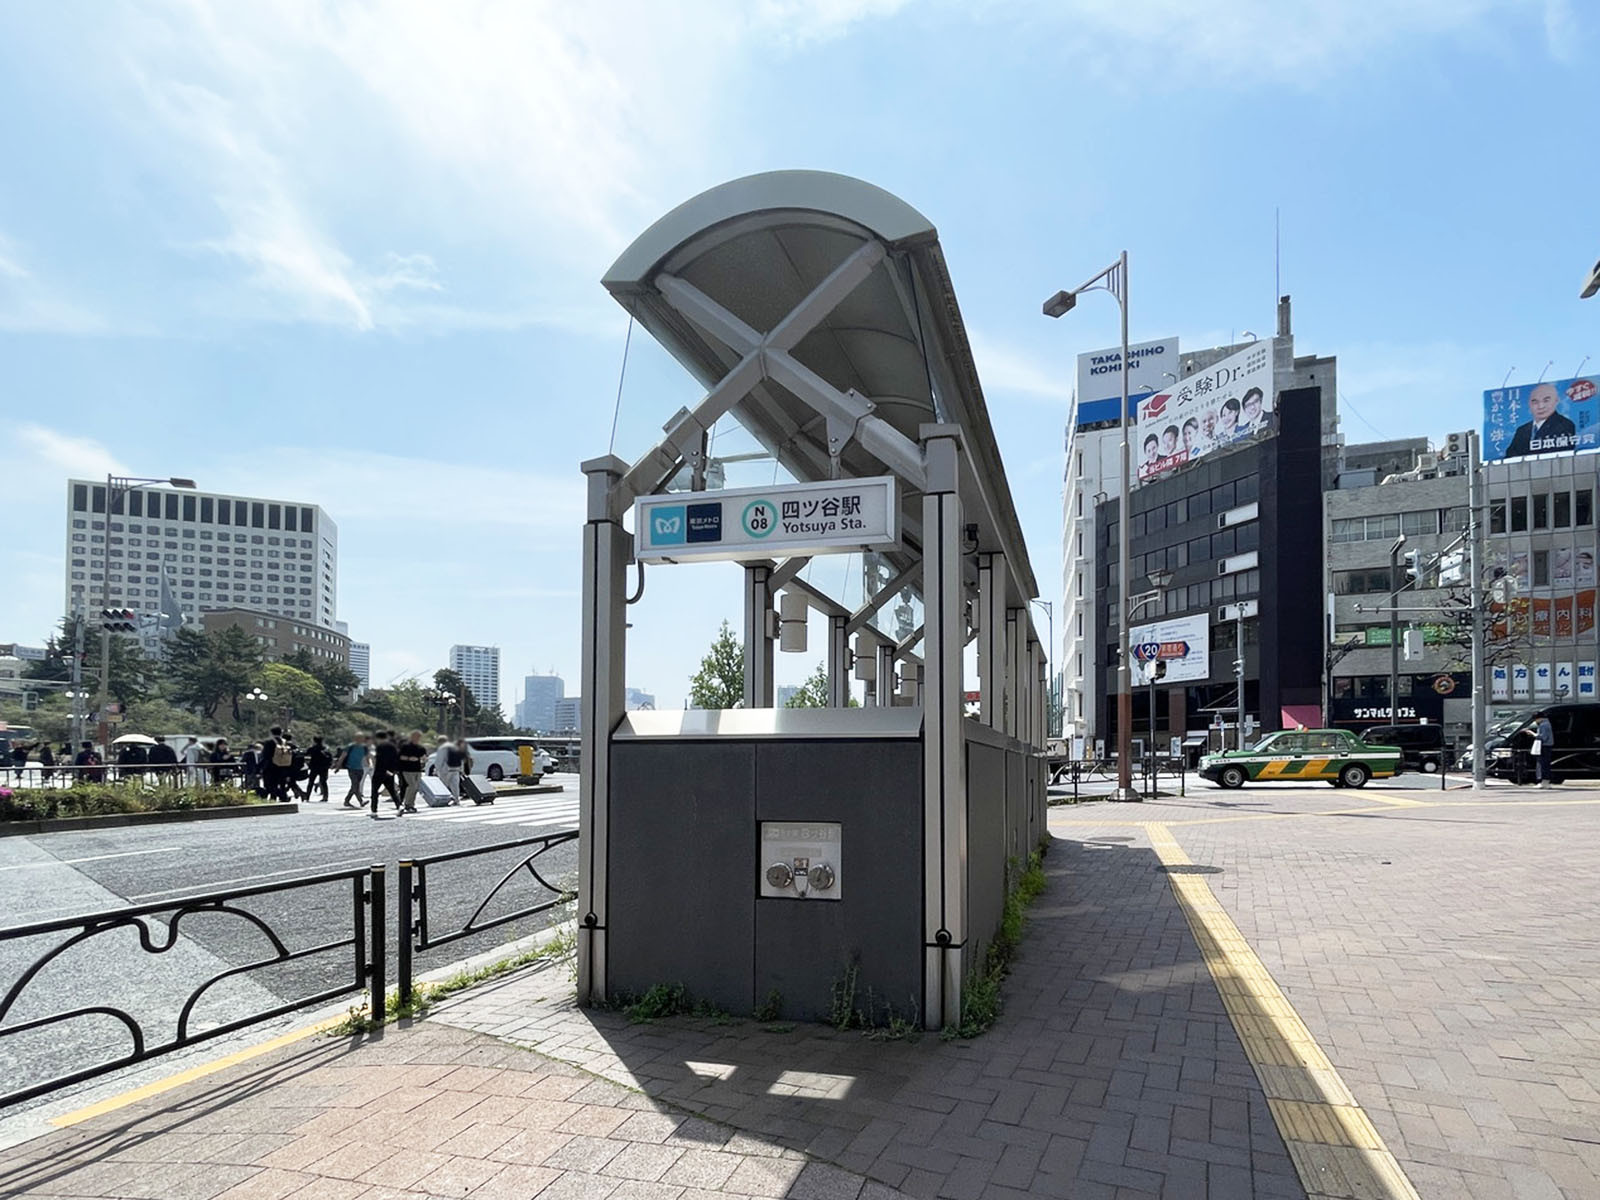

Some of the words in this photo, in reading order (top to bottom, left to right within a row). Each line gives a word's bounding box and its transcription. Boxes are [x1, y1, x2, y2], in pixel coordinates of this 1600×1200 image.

[1177, 366, 1245, 407] 受験Dr.
[754, 506, 765, 517] N
[782, 495, 861, 520] 四ツ谷駅
[750, 518, 768, 530] 08
[782, 521, 836, 535] Yotsuya
[840, 517, 867, 530] Sta.
[1144, 644, 1158, 656] 20
